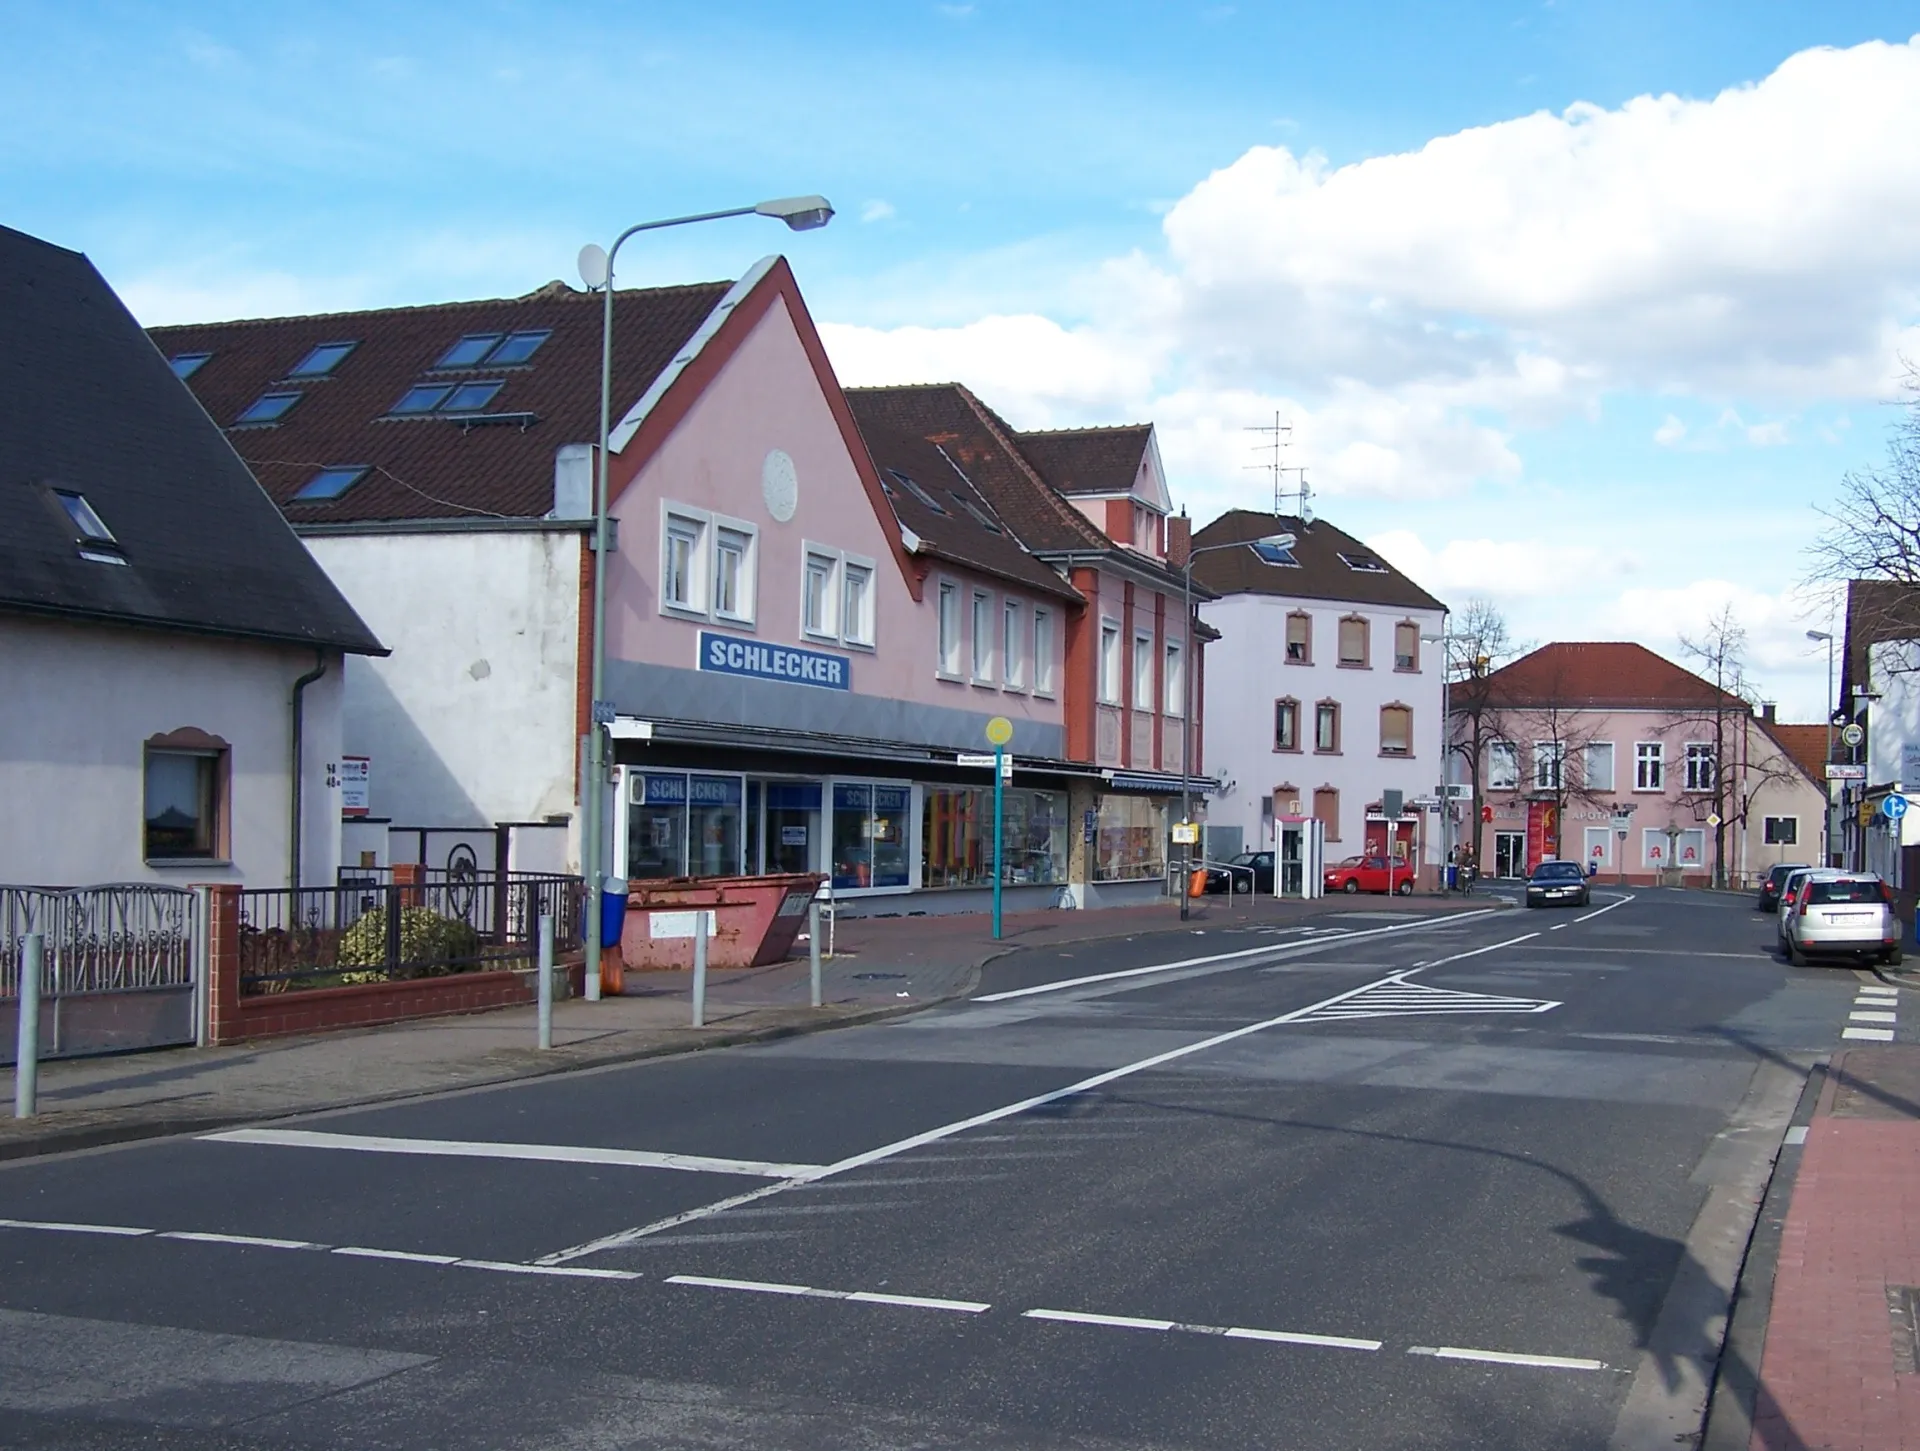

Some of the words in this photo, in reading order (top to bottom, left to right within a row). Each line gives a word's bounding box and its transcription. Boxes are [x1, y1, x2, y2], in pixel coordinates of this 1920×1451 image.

[709, 640, 842, 684] SCHLECKER
[651, 779, 727, 800] SCHLECKER
[846, 789, 902, 808] SCHLECKER
[1571, 811, 1634, 821] APOTHE
